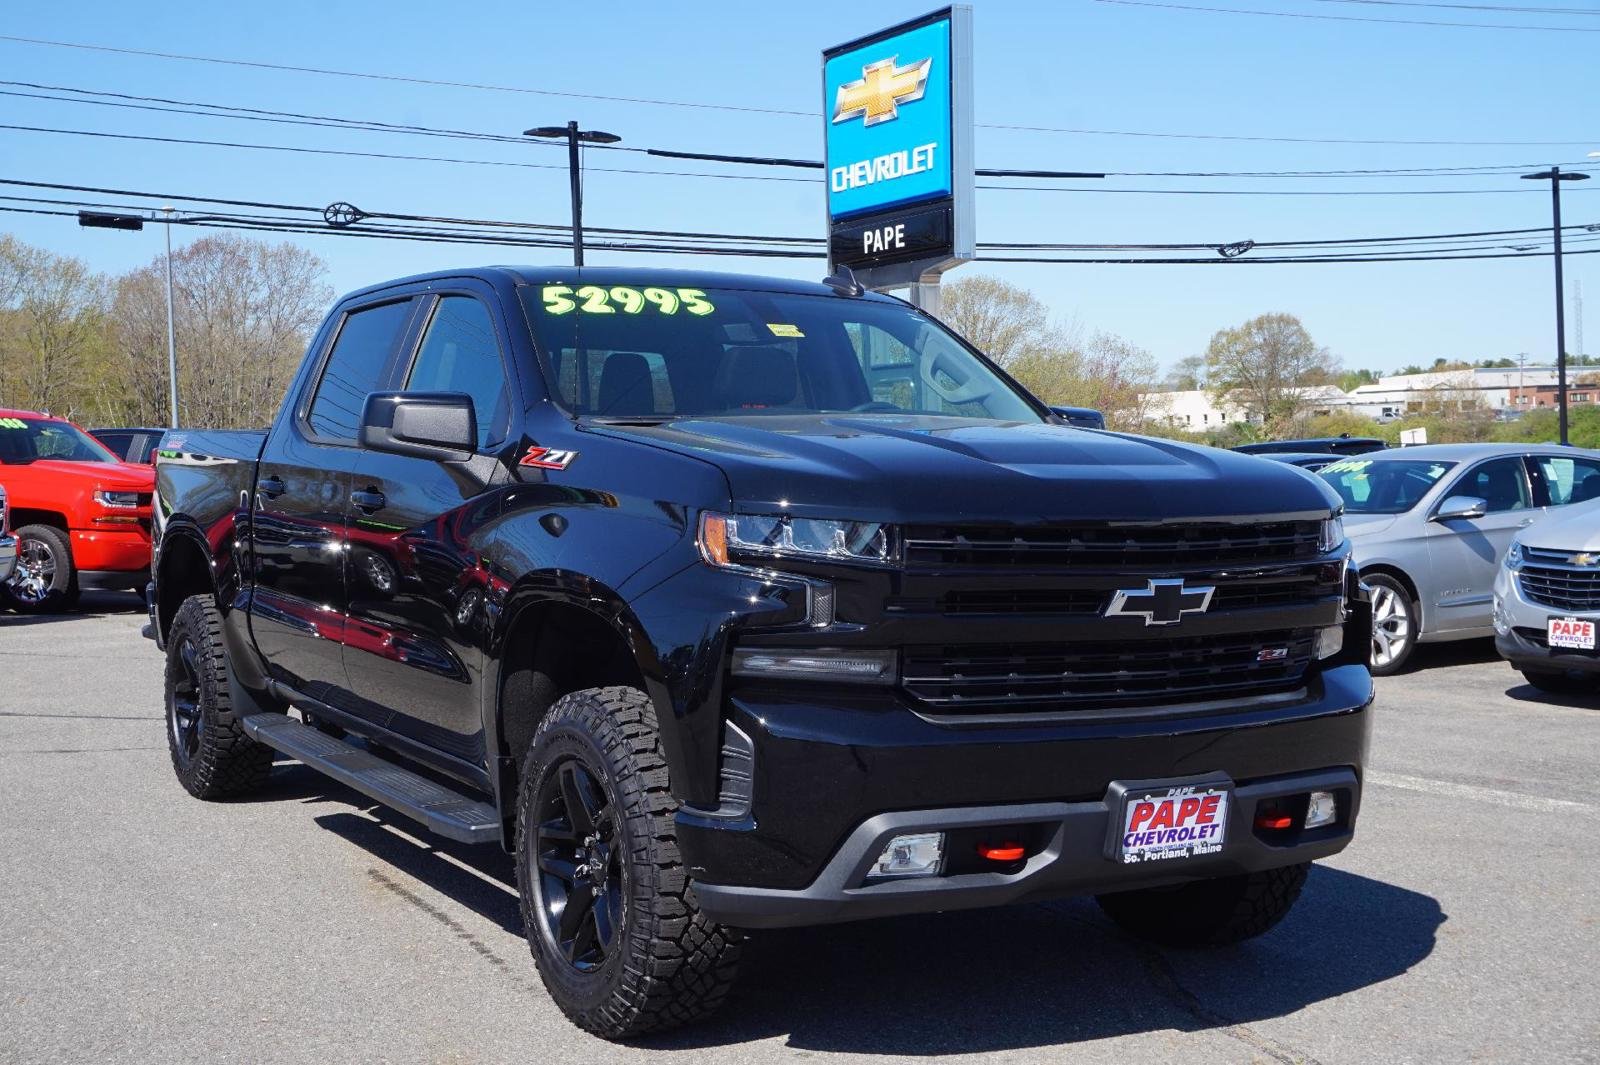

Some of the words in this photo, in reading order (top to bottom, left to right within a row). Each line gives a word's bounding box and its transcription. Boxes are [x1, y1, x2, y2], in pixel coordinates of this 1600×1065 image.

[832, 142, 937, 193] CHEVROLET
[863, 224, 905, 254] PAPE
[542, 286, 715, 315] 52995
[519, 446, 579, 470] Z71
[1550, 634, 1592, 643] CHEVROLET
[1552, 622, 1591, 636] PAPE
[1129, 795, 1221, 832] PAPE
[1123, 823, 1220, 848] CHEVROLET
[1124, 853, 1140, 863] So.
[1144, 847, 1190, 861] Portland,
[1193, 843, 1222, 856] Maine
